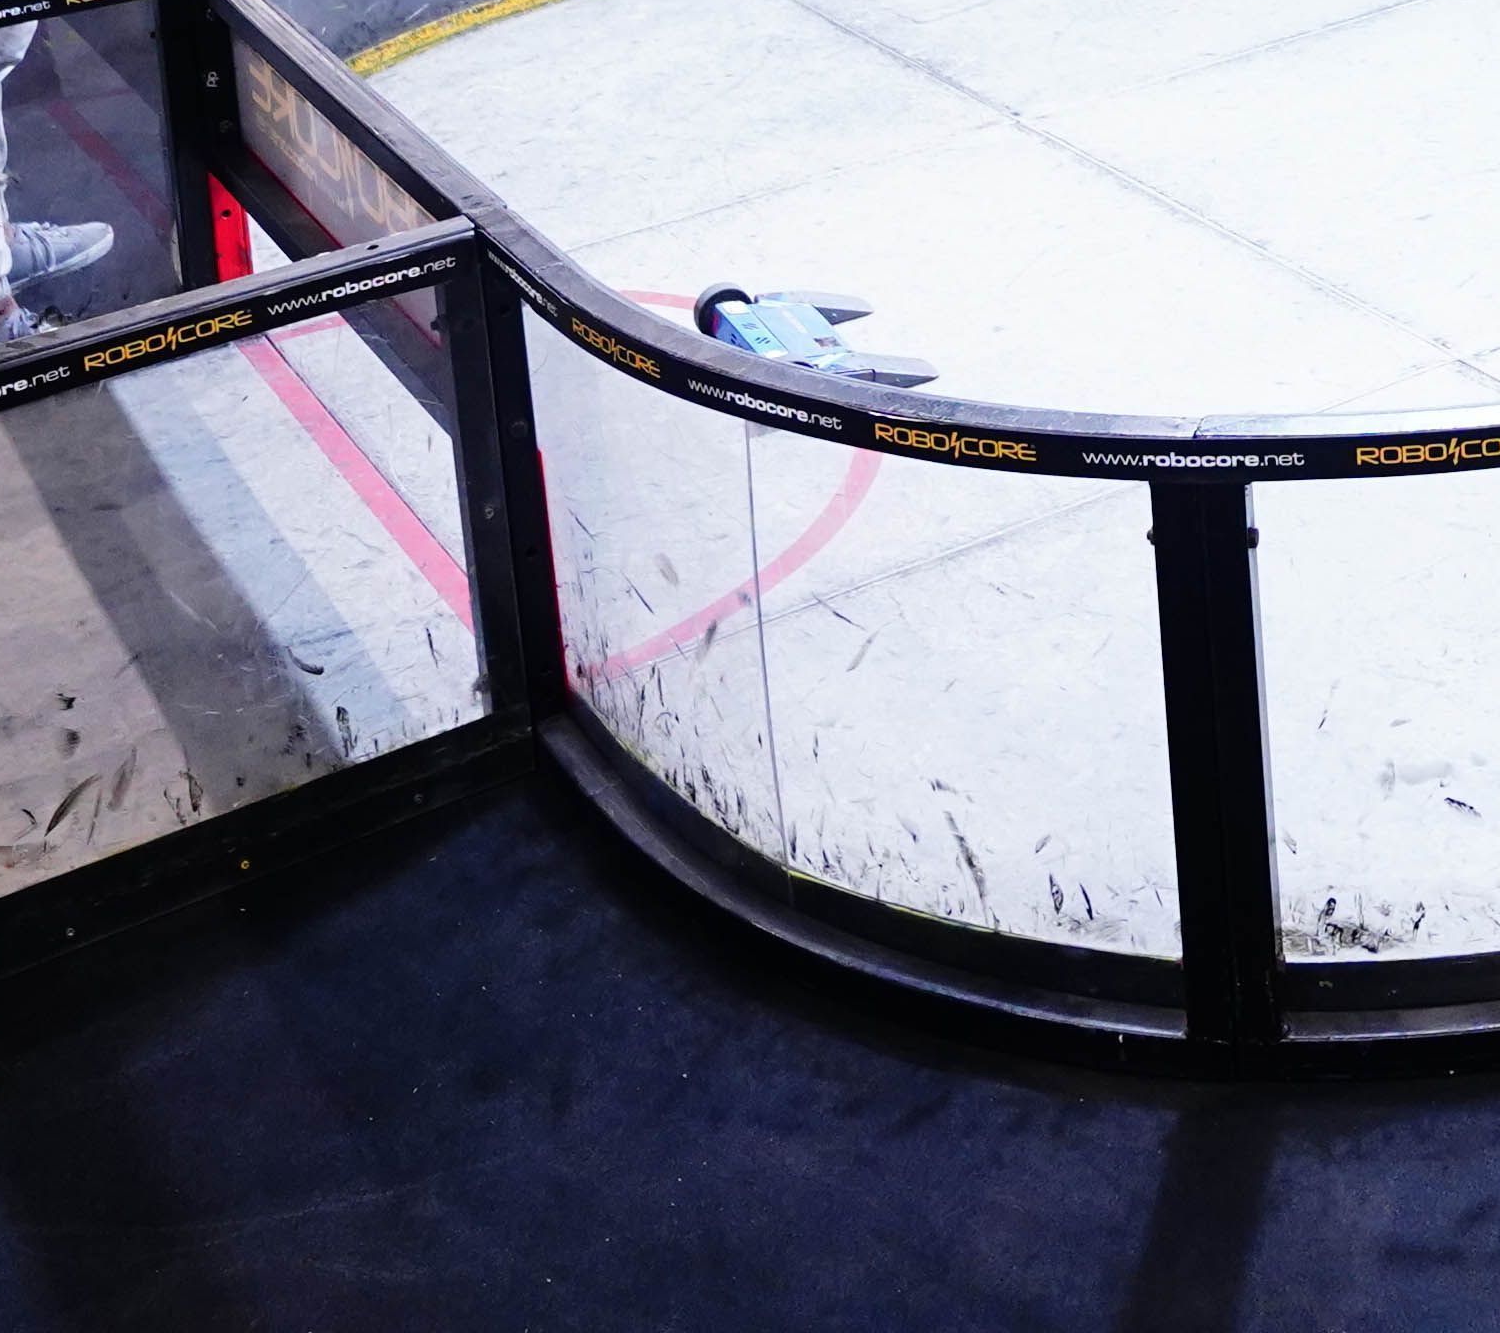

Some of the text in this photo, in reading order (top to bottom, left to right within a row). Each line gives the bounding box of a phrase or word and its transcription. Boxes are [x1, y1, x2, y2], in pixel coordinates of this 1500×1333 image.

[267, 253, 457, 316] www.robocore.net
[687, 377, 843, 431] www.robocore.net
[1083, 450, 1306, 469] www.robocore.net
